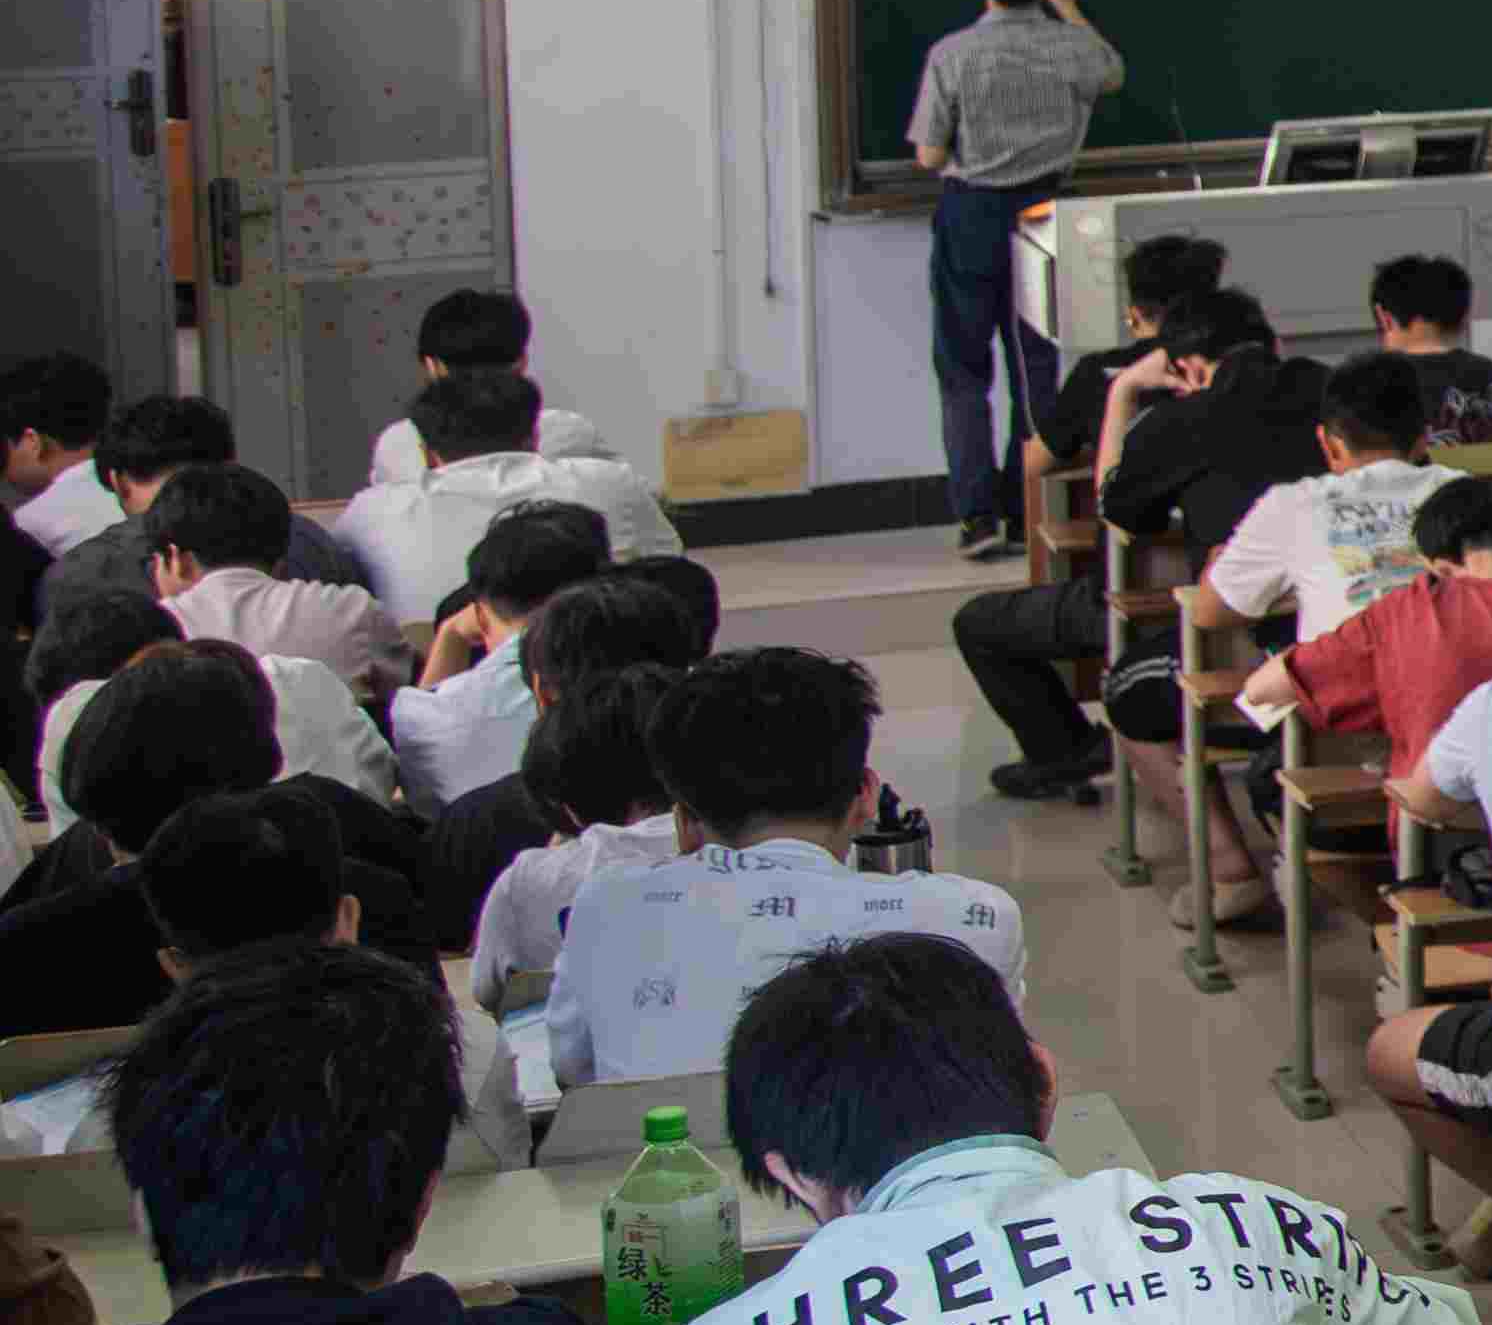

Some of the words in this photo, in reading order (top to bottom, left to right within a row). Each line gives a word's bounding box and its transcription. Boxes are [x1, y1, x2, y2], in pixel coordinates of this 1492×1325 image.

[618, 1247, 672, 1316] 绿茶
[1129, 1192, 1430, 1308] STRI
[1073, 1272, 1168, 1315] THE
[1189, 1265, 1212, 1292] 3
